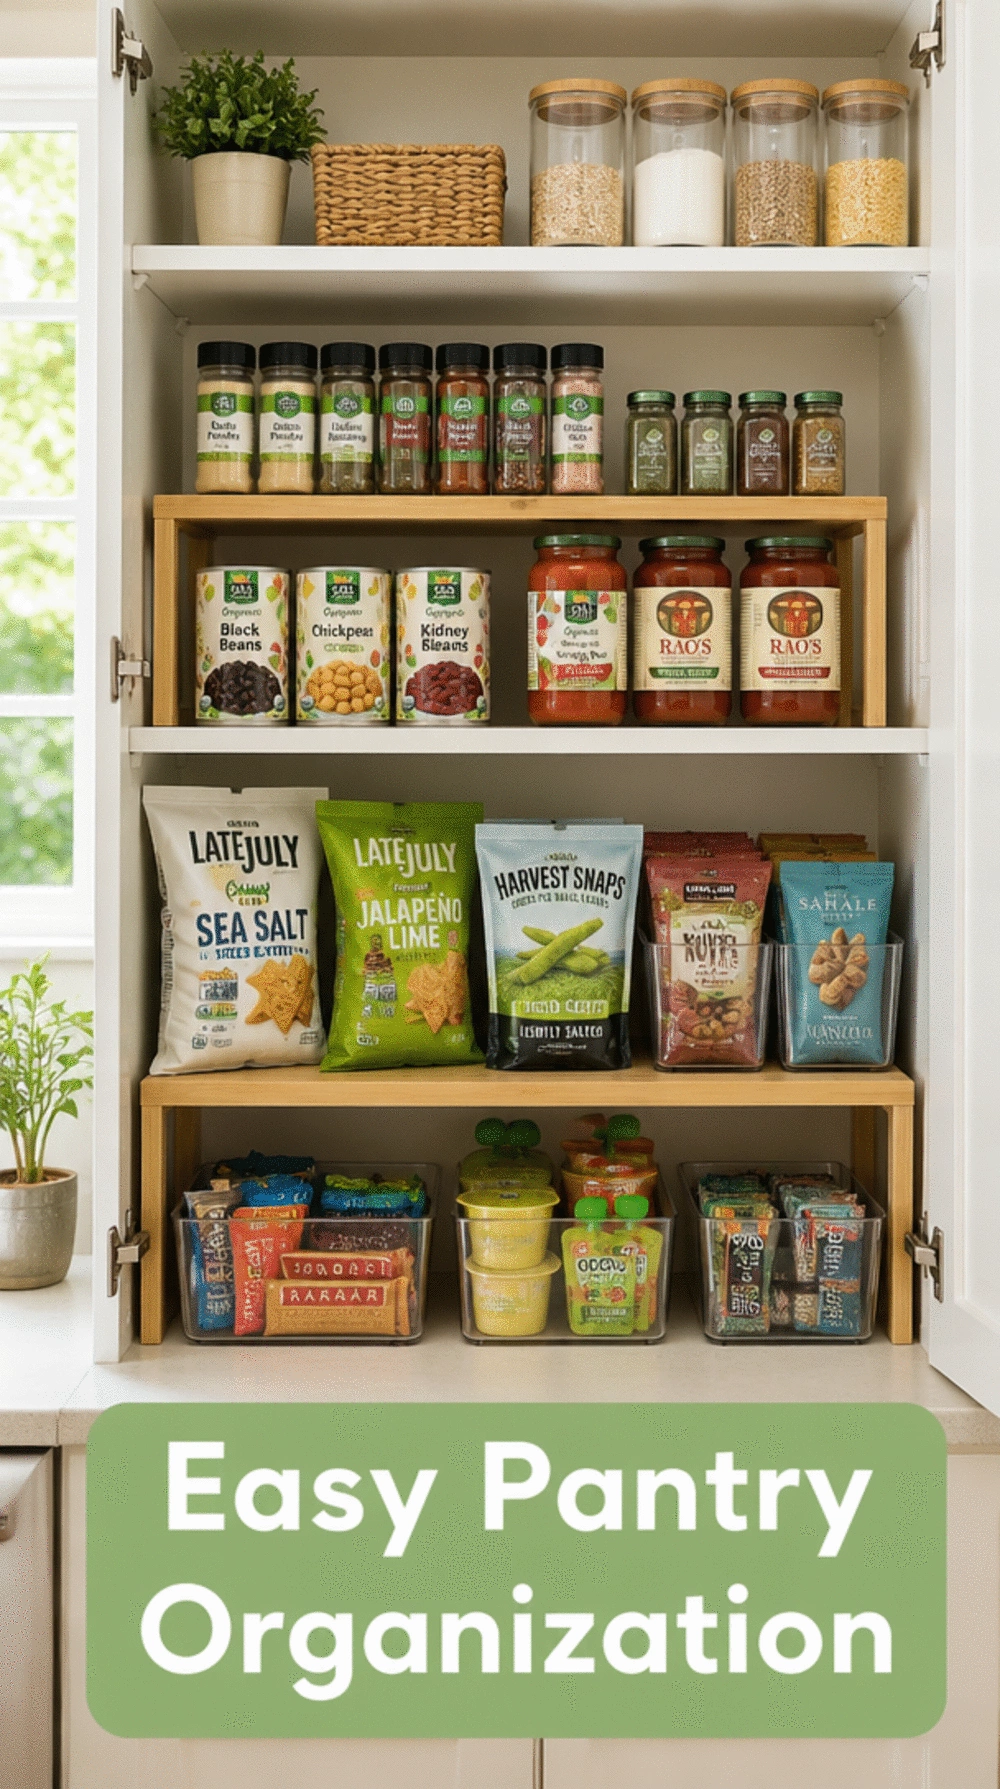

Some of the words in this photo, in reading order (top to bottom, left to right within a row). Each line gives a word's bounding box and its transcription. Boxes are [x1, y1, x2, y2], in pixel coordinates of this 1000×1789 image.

[220, 622, 260, 636] Black
[421, 623, 469, 640] Kidney
[219, 638, 262, 651] Beans
[659, 638, 712, 654] RAO'S
[770, 639, 822, 654] RAO'S
[494, 865, 569, 900] HARVEST
[573, 866, 626, 900] SNAPS
[196, 911, 248, 947] SEA
[254, 909, 308, 942] SALT
[389, 924, 440, 949] LIME
